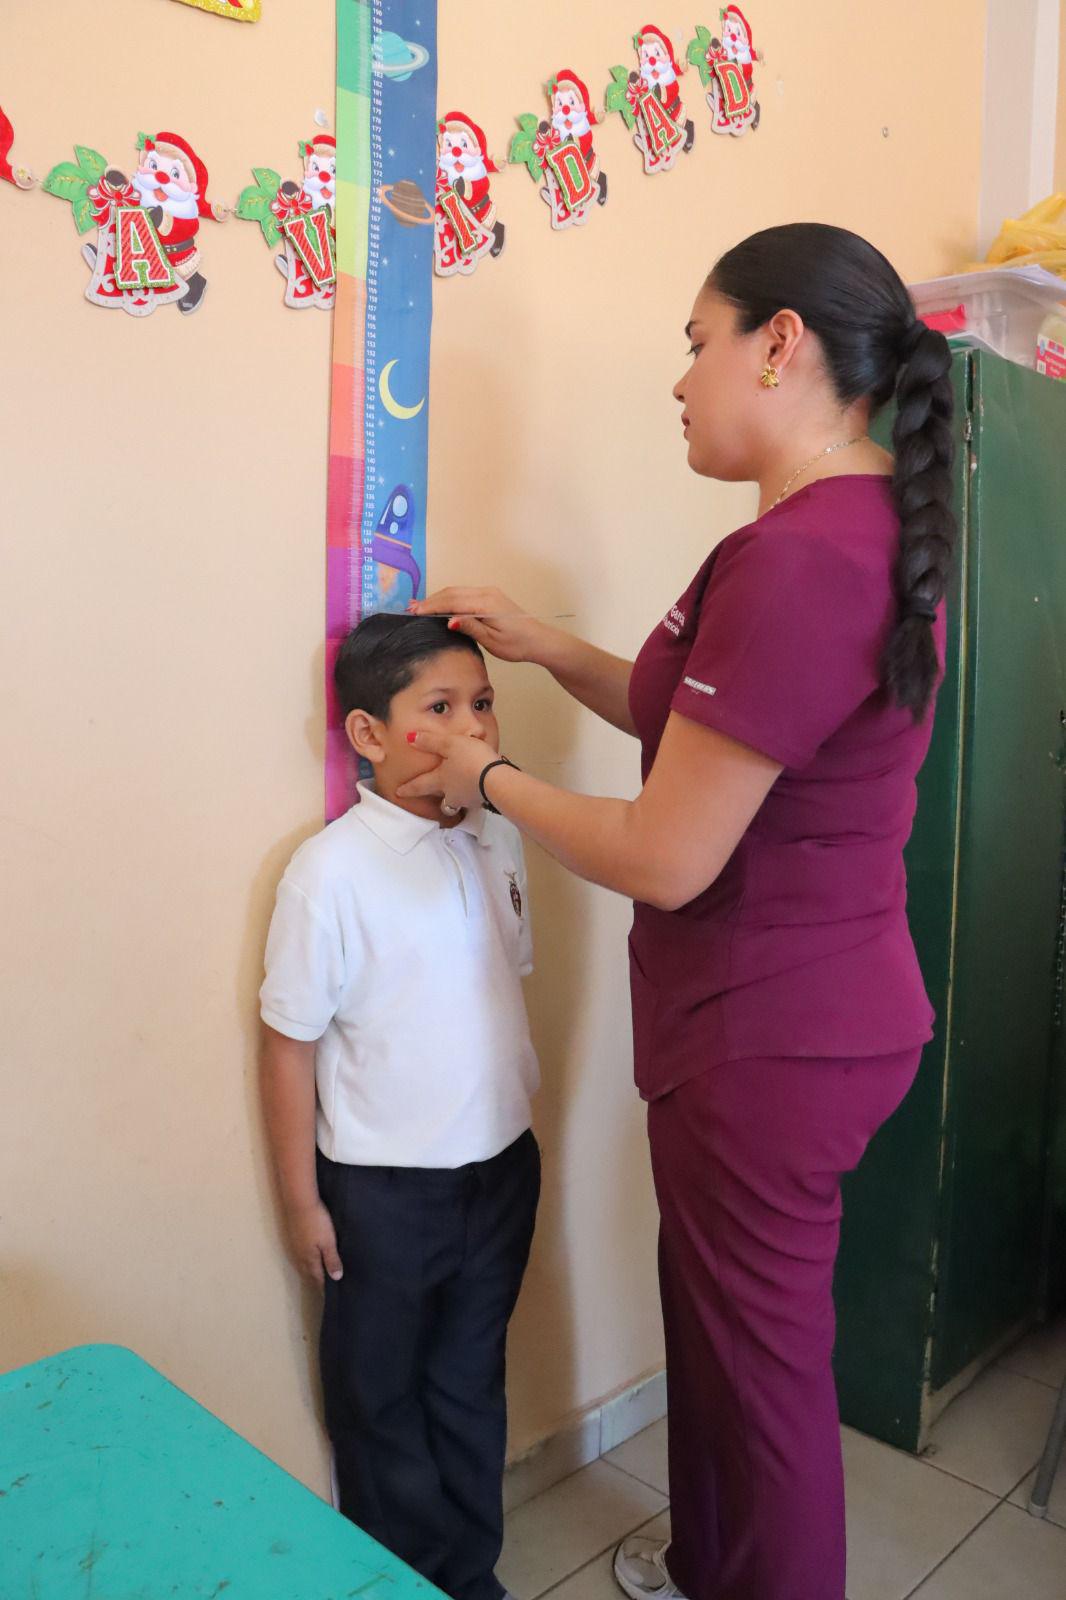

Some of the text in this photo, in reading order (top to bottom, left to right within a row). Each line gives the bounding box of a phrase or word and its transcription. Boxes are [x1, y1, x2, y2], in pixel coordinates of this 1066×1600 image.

[118, 61, 749, 285] A V I D A D
